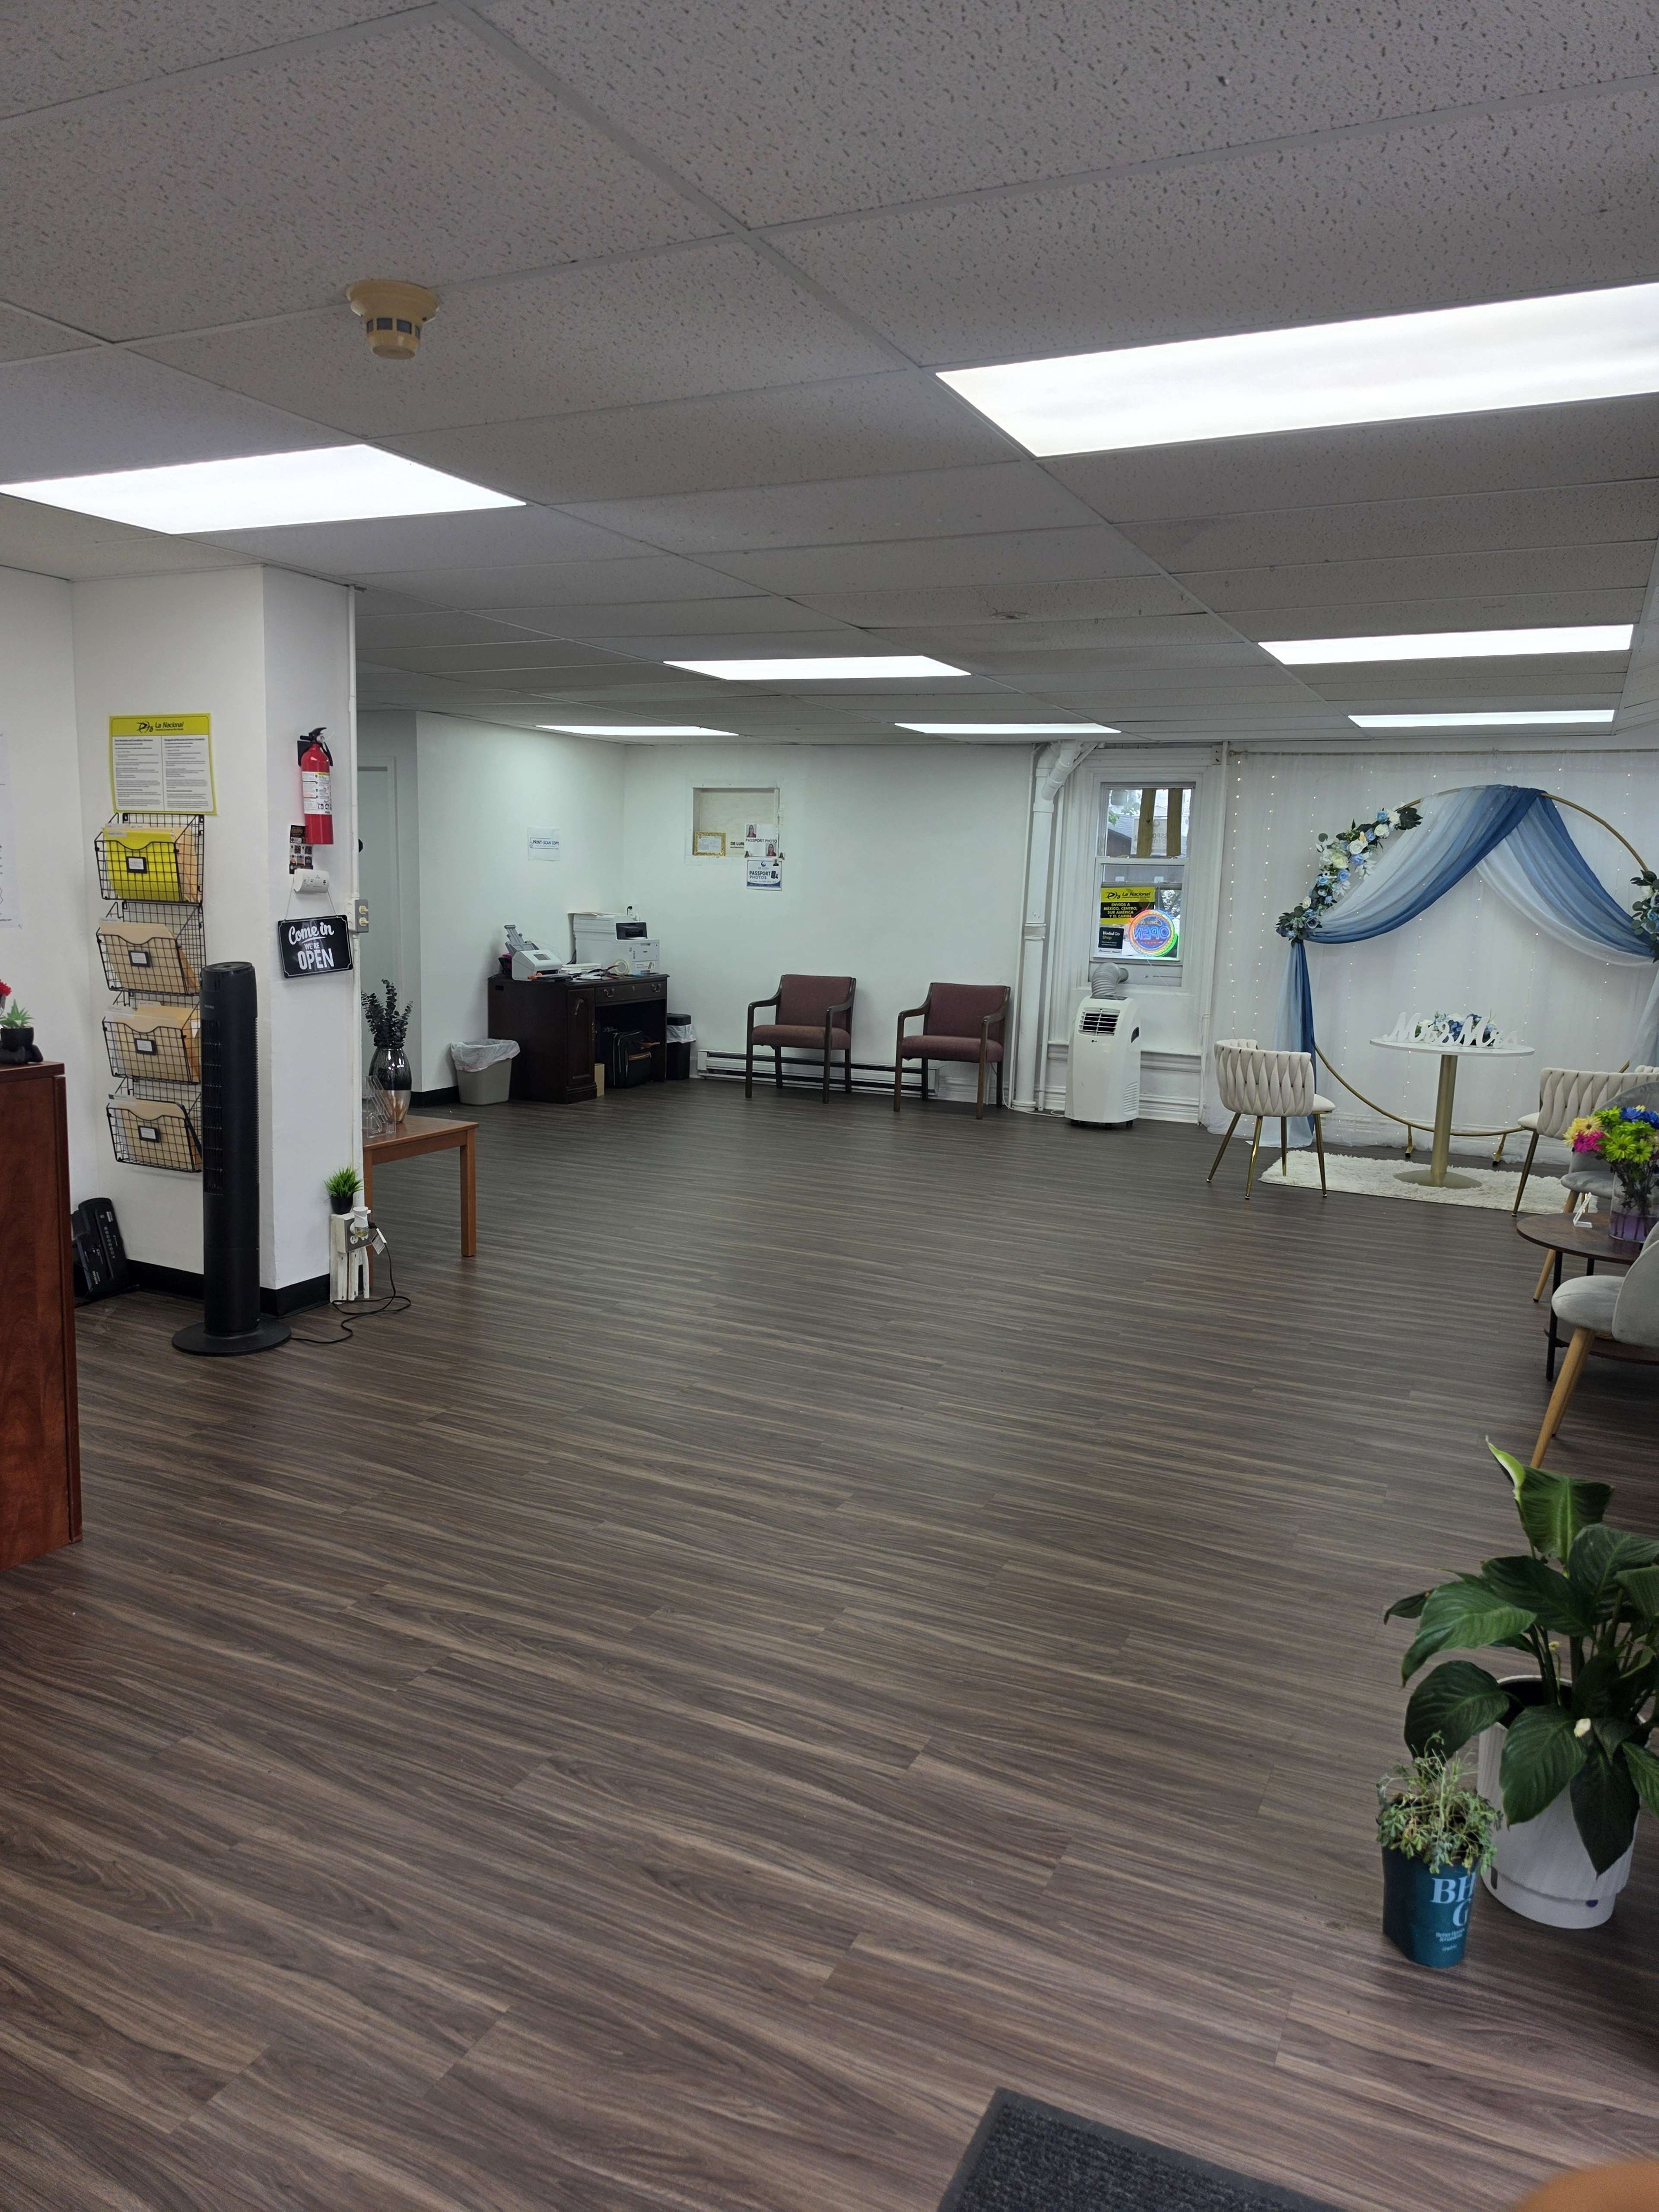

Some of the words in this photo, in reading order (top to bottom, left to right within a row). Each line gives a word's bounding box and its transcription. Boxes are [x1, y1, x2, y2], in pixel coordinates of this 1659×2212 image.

[288, 926, 319, 945] Come
[320, 922, 334, 936] in
[297, 948, 334, 970] OPEN
